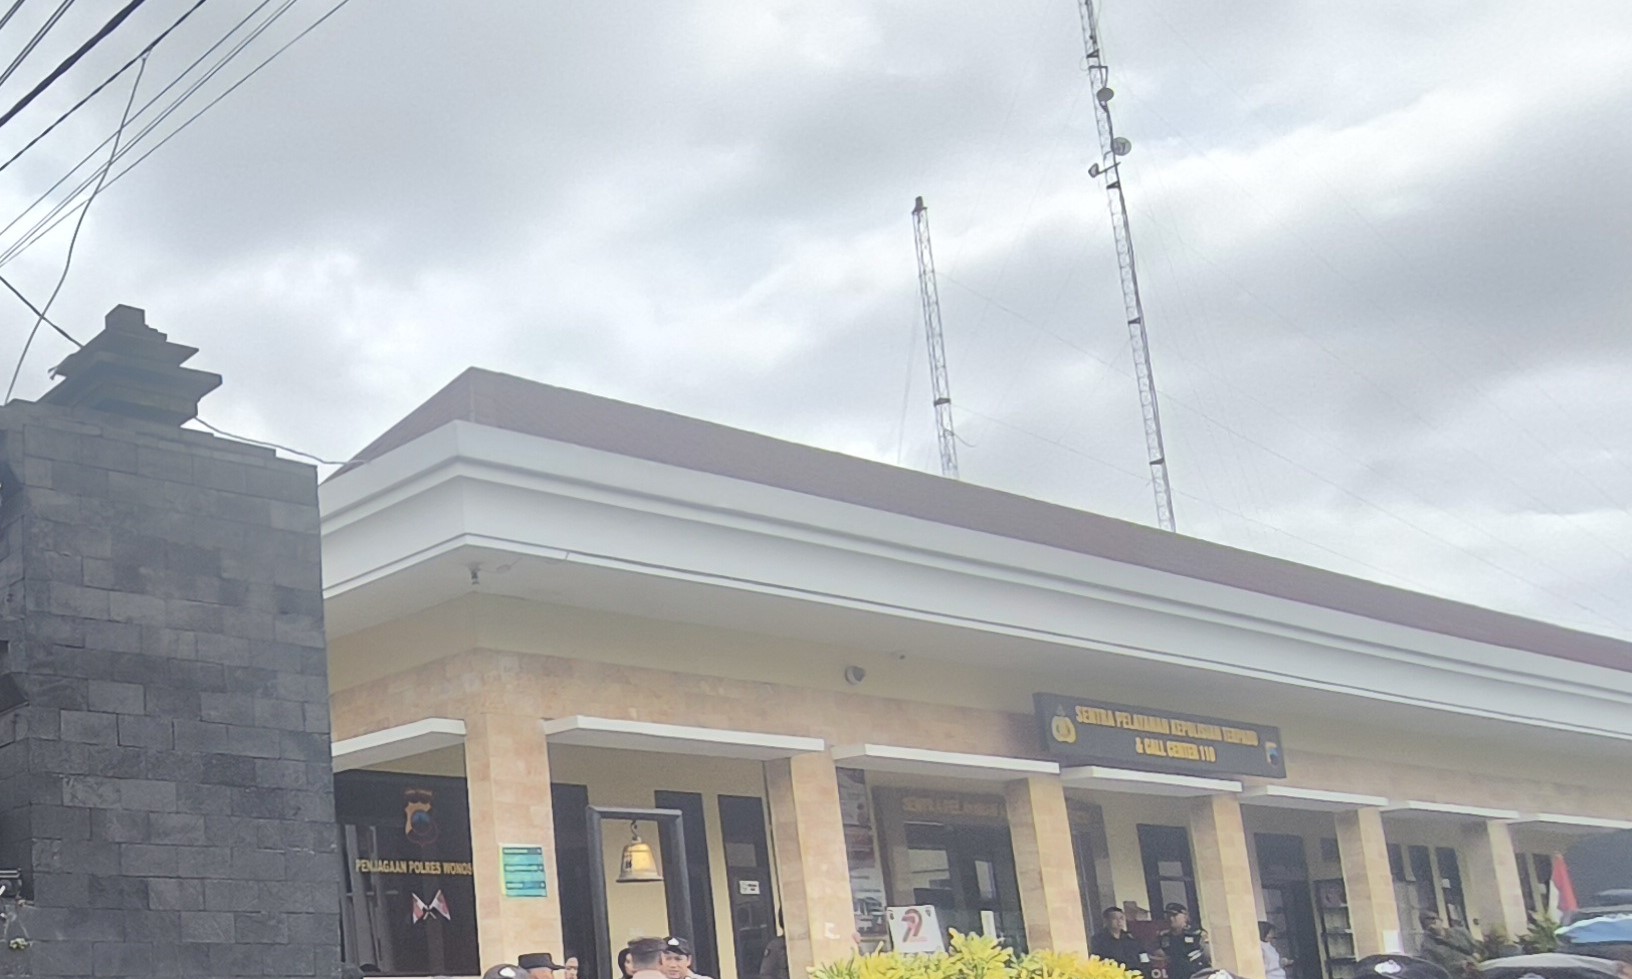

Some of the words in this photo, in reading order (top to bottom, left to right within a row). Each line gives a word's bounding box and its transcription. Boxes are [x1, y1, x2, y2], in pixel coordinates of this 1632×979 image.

[1144, 739, 1167, 757] CALL
[356, 859, 408, 873] PENJAGAAN
[409, 862, 442, 874] POLRES
